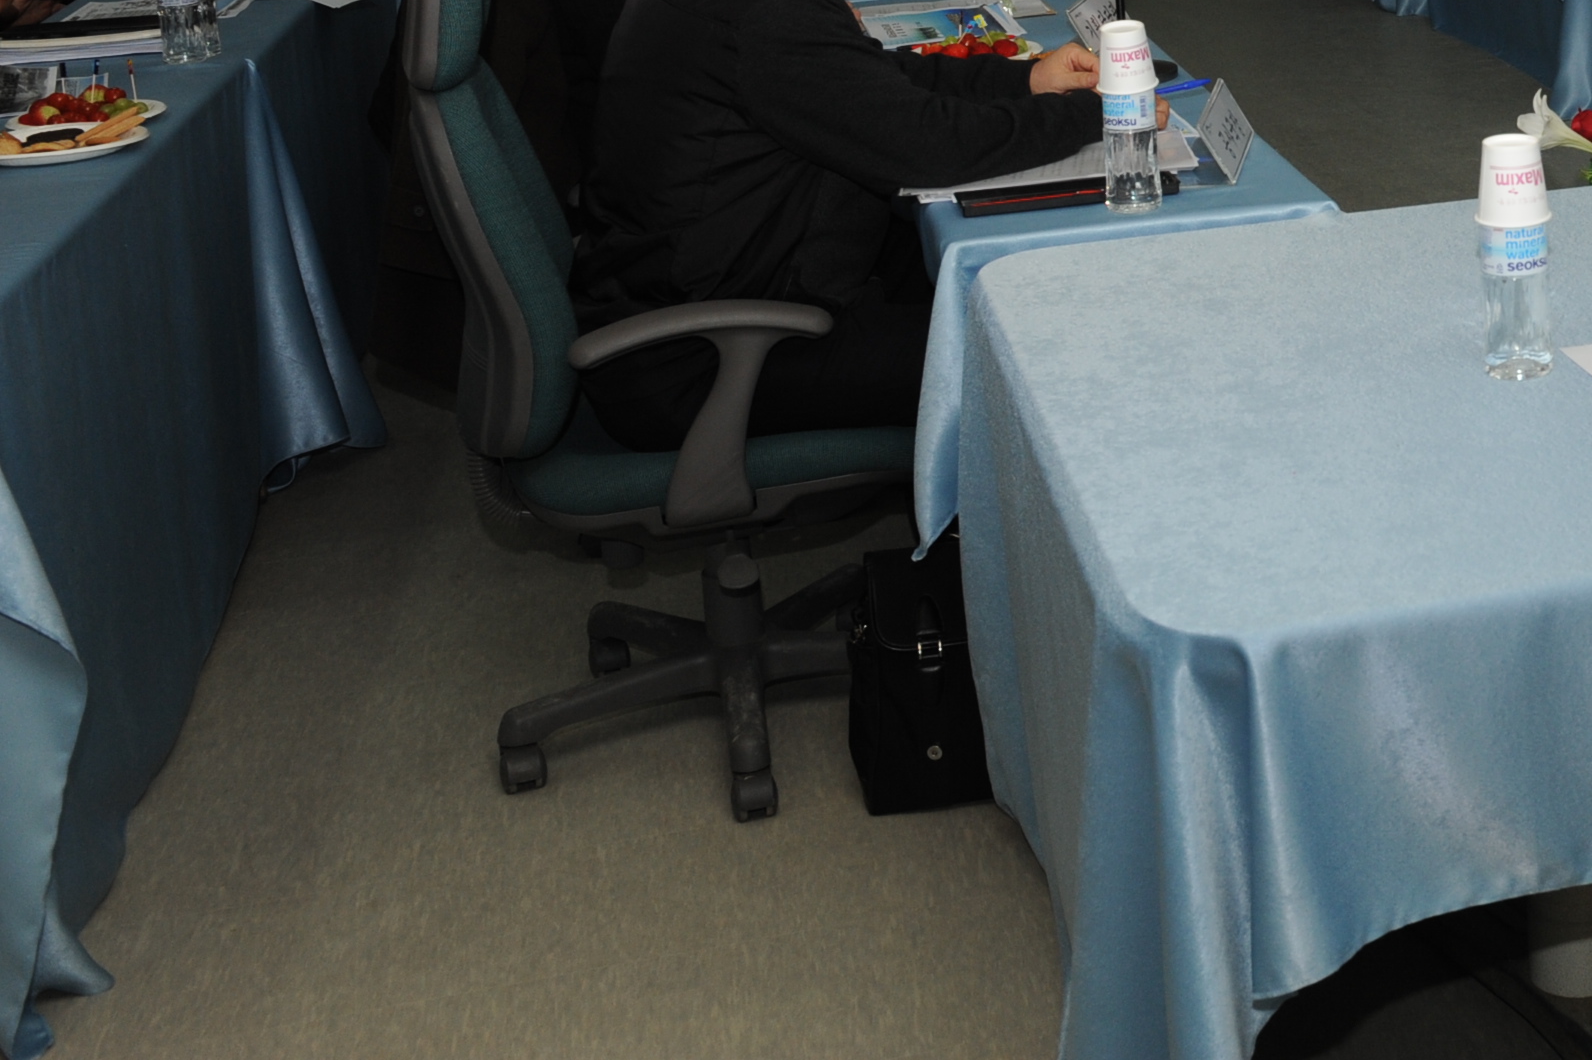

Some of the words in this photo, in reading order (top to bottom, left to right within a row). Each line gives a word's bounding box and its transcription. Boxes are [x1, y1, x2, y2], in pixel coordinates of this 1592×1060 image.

[1110, 47, 1150, 63] Maxim
[1495, 168, 1544, 187] Maxim
[1507, 247, 1541, 260] water
